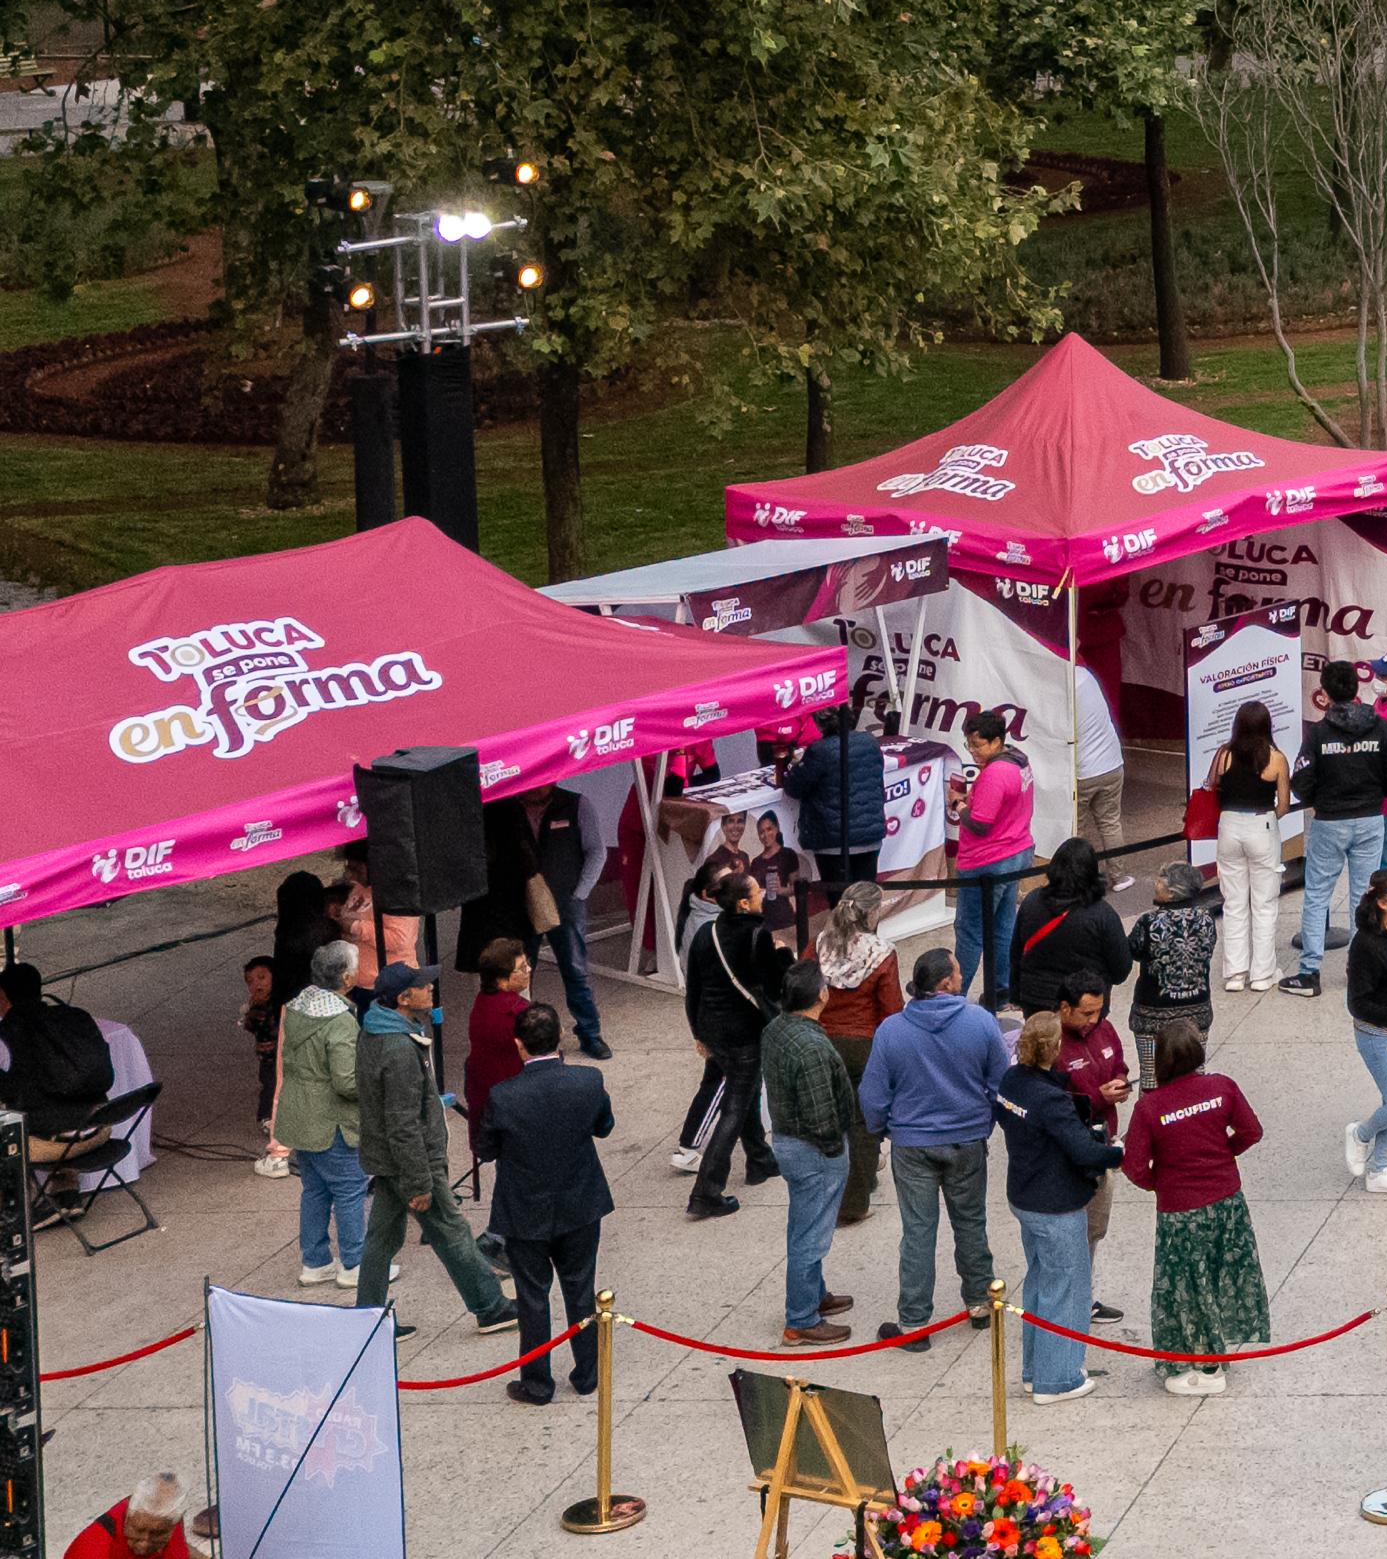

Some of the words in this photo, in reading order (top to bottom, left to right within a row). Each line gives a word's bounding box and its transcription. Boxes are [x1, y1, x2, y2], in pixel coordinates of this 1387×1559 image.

[1169, 454, 1260, 489] forma
[1285, 485, 1317, 506] DIF
[772, 507, 807, 524] DIF
[1123, 527, 1158, 554] DIF
[1207, 537, 1319, 565] OLUCA
[906, 557, 932, 573] DIF
[1238, 567, 1283, 585] pone
[1016, 581, 1049, 599] DIF
[1139, 578, 1197, 612] en
[1279, 605, 1296, 619] DIF
[138, 623, 316, 675] TOLUCA
[212, 666, 237, 682] se
[239, 653, 291, 675] pone
[1200, 661, 1259, 684] VALORACIÓN
[1261, 653, 1290, 669] FÍSICA
[799, 669, 837, 697] DIF
[118, 710, 205, 758] en
[206, 657, 433, 753] forma
[593, 717, 636, 746] DIF
[596, 738, 635, 755] toluca
[124, 839, 177, 869] DIF
[127, 861, 173, 881] toluca
[1160, 1096, 1224, 1126] IMCUFIDET
